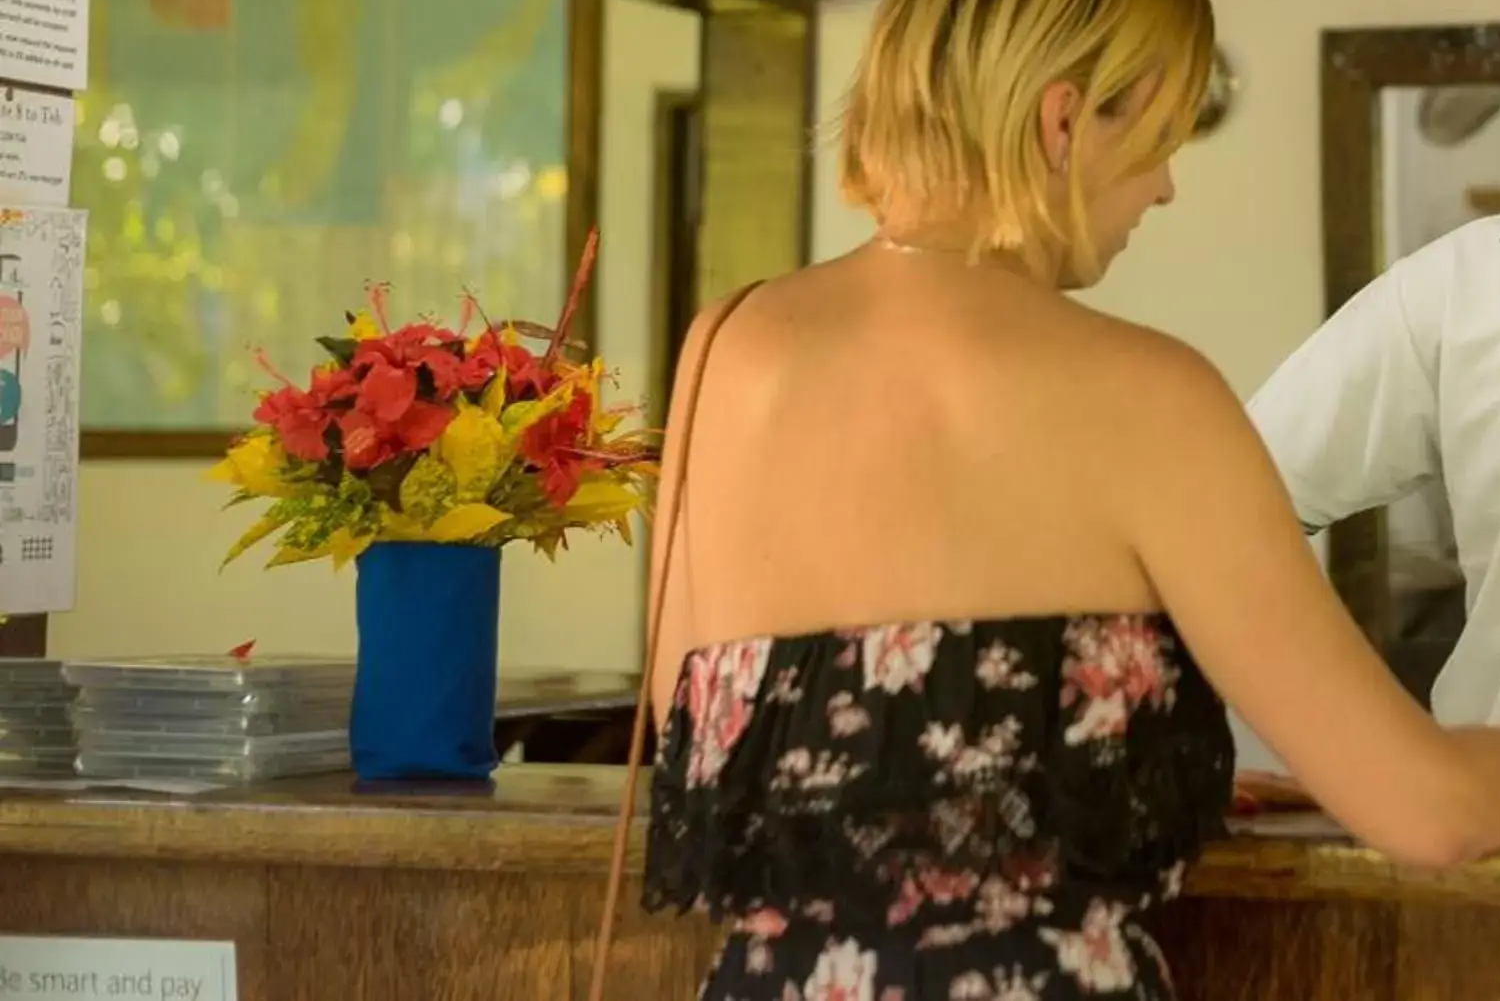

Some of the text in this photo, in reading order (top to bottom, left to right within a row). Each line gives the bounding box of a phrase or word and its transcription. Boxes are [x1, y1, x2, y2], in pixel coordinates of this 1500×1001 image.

[28, 970, 98, 997] smart
[106, 967, 152, 996] and
[160, 975, 203, 1001] pay
